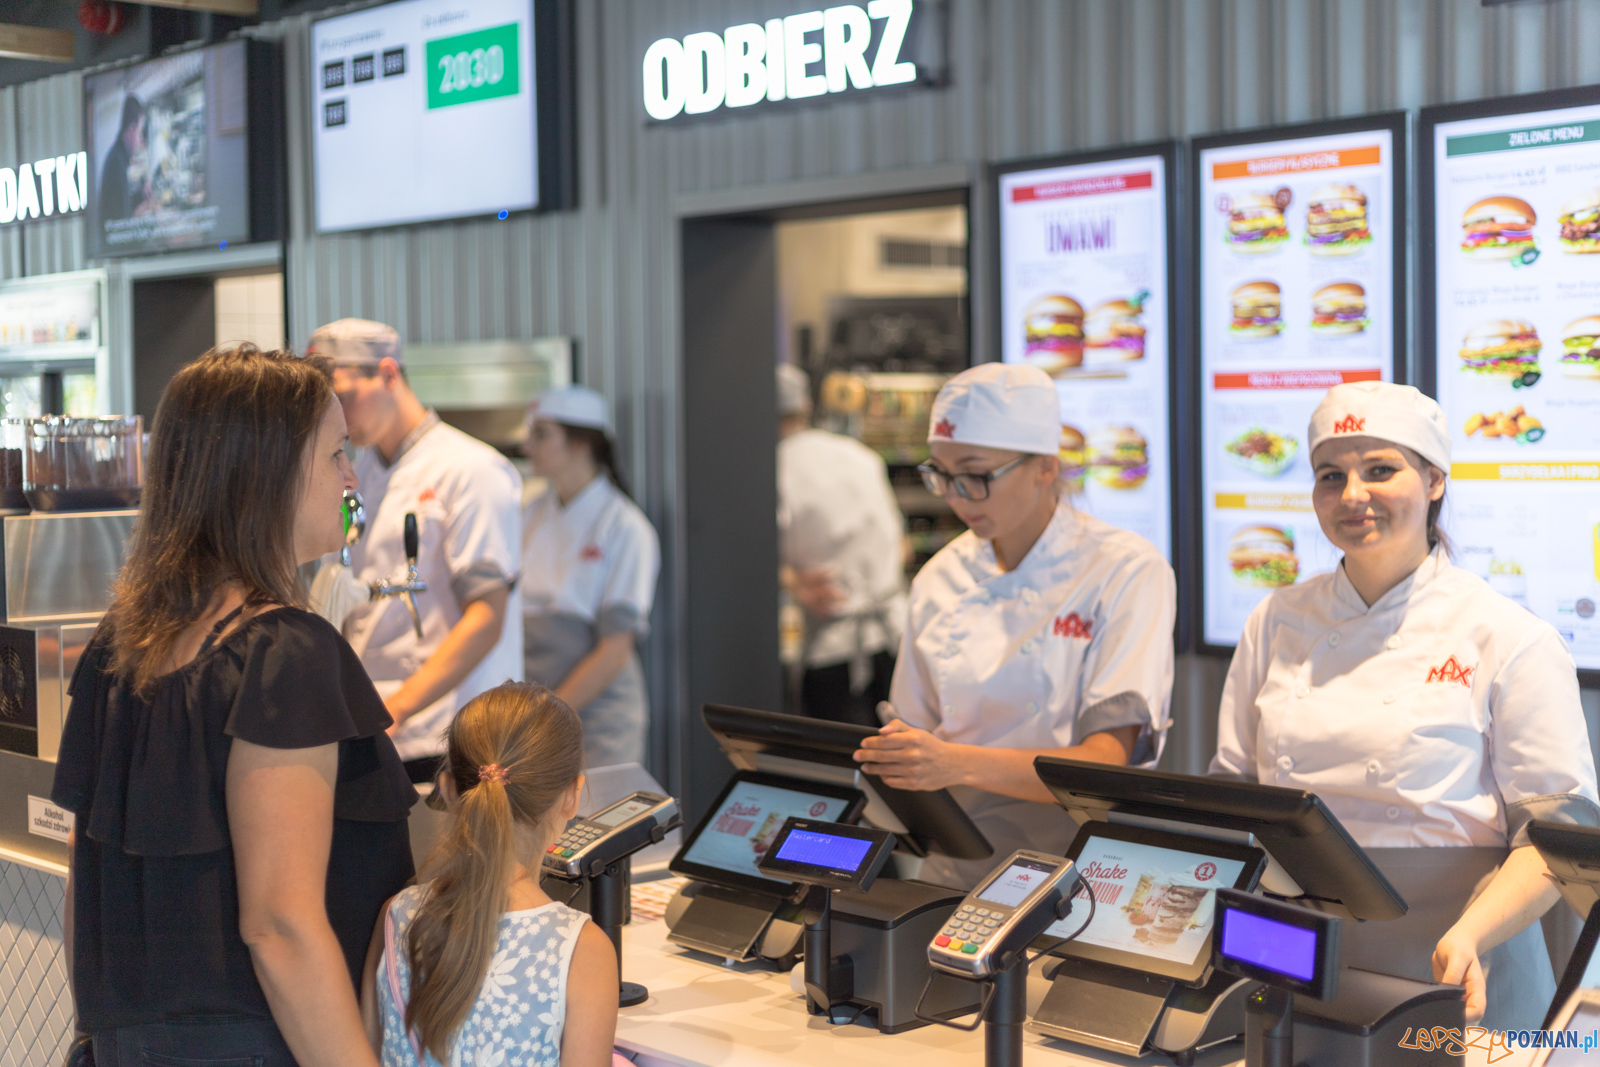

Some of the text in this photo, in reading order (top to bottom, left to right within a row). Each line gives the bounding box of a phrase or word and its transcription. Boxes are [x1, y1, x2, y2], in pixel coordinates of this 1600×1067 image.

[438, 44, 505, 94] 2030
[643, 0, 916, 120] ODBIERZ
[1508, 125, 1585, 147] ZIELONE MENU
[1333, 412, 1366, 435] MAX
[1053, 611, 1093, 641] MAX
[1425, 655, 1474, 688] MAX
[44, 807, 65, 822] Alkohol
[1080, 860, 1128, 880] Shake
